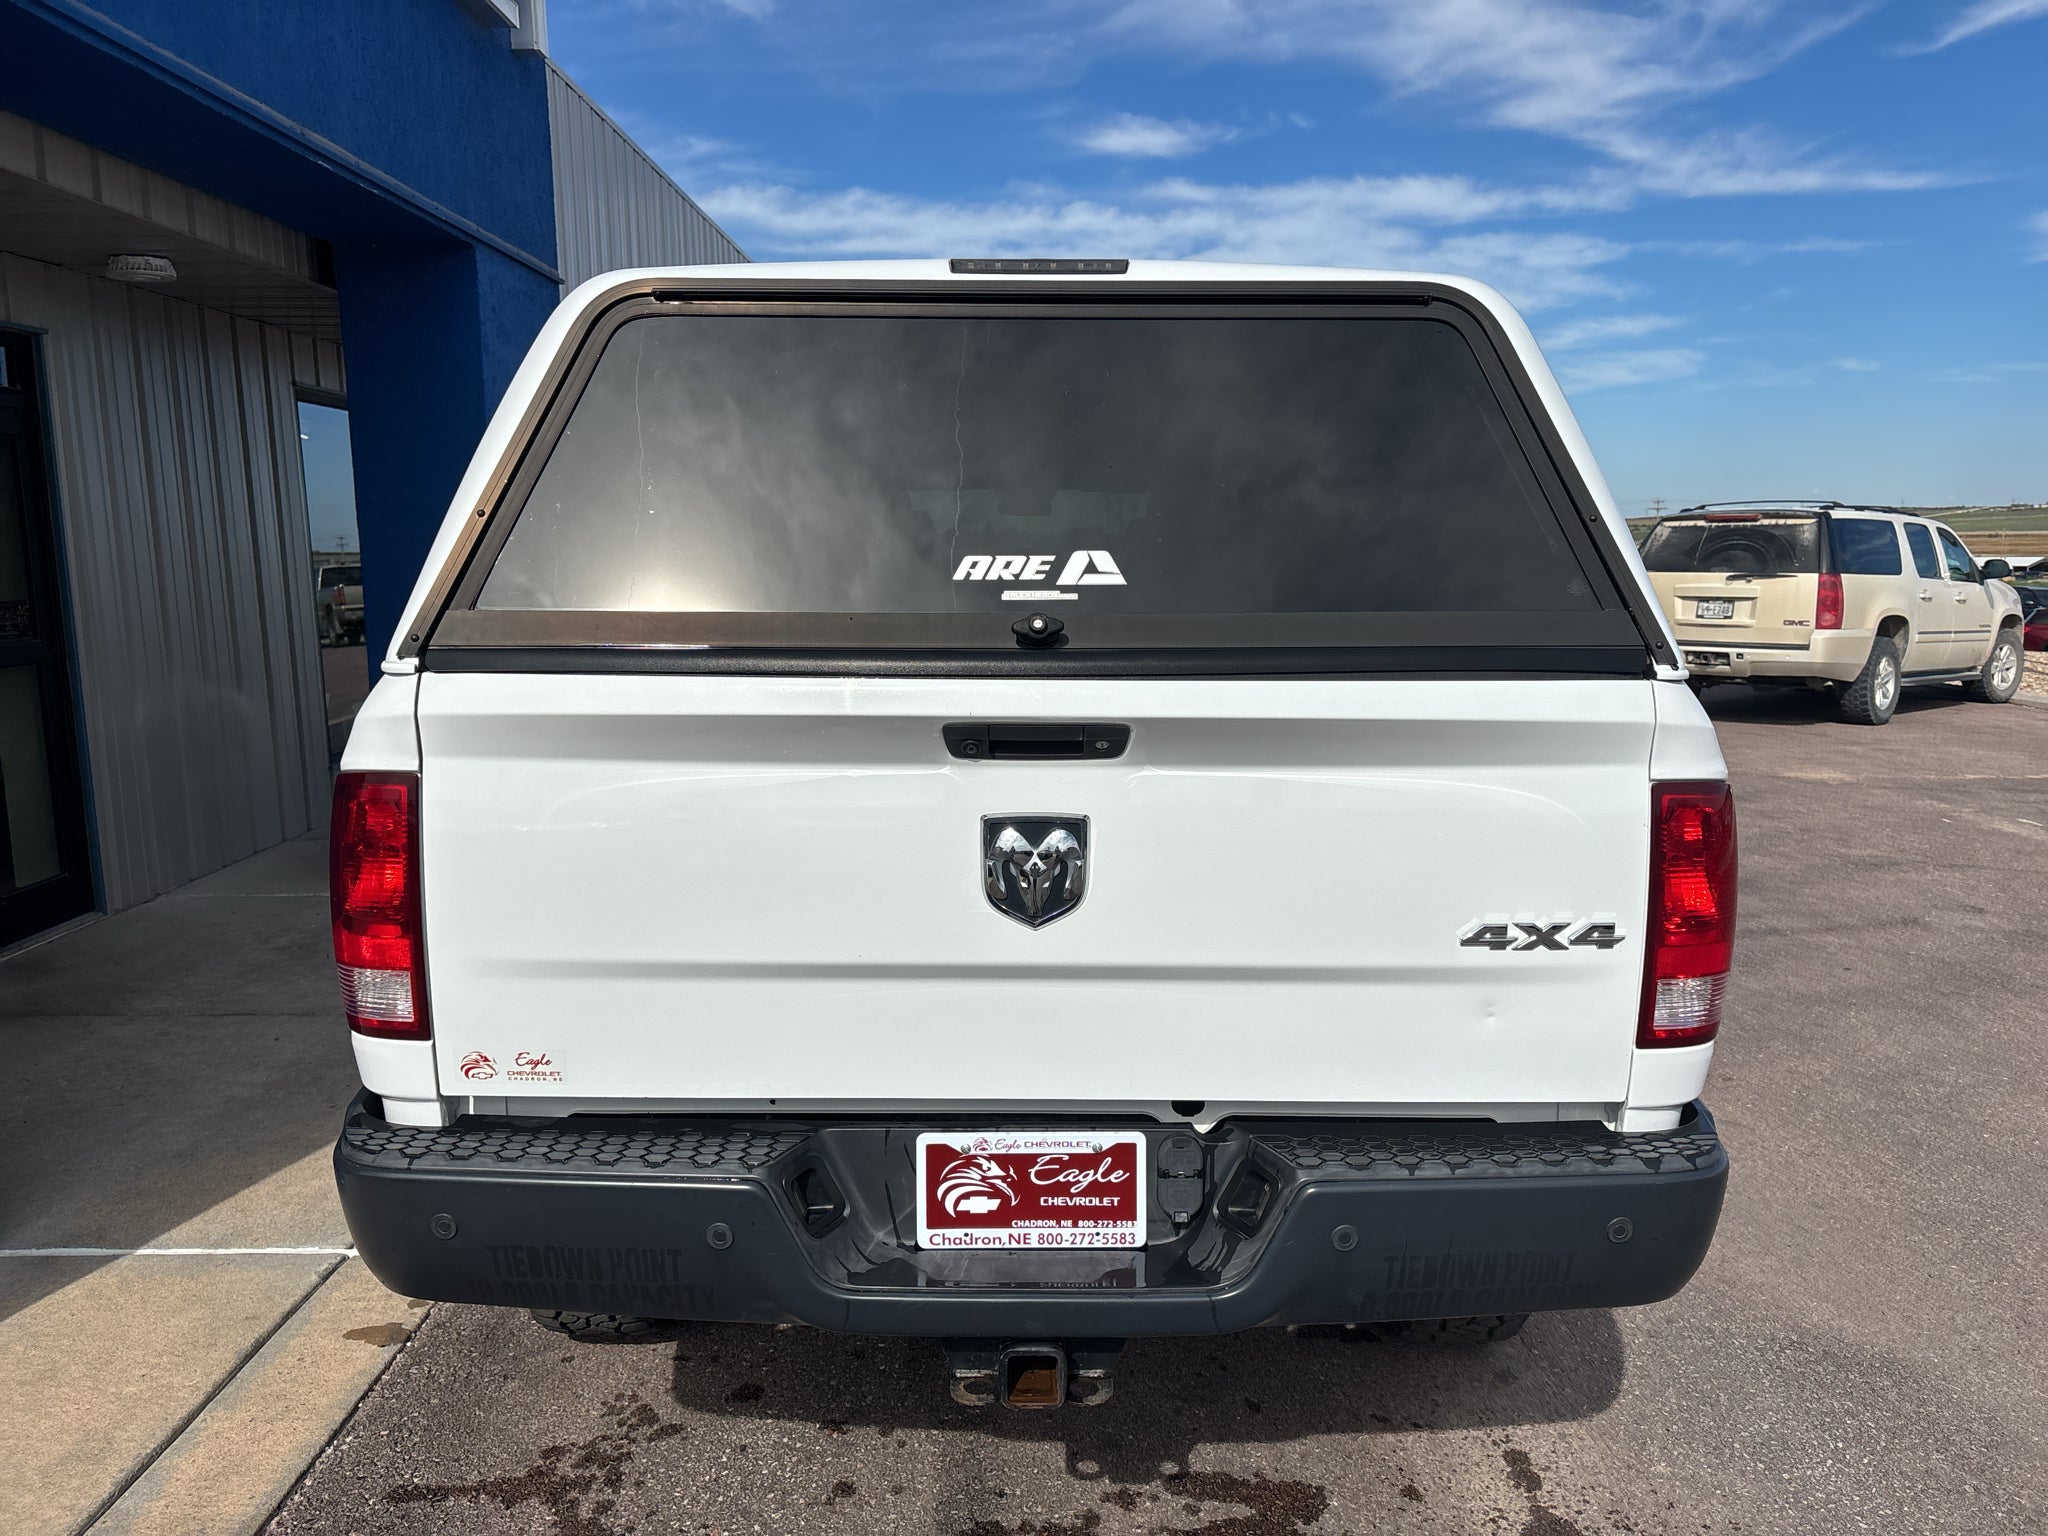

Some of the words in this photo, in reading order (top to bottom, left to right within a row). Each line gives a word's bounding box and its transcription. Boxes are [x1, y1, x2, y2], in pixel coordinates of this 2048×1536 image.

[952, 555, 1057, 581] ARE
[1459, 922, 1626, 951] 4X4
[514, 1051, 553, 1070] Eagle
[994, 1138, 1022, 1153] Eagle
[1023, 1140, 1092, 1148] CHEVROLET
[1028, 1154, 1130, 1194] Eagle
[1039, 1196, 1121, 1207] CHEVROLET
[1011, 1219, 1059, 1229] CHADRON,
[1060, 1219, 1073, 1228] NE
[1037, 1232, 1136, 1246] 800-272-5583
